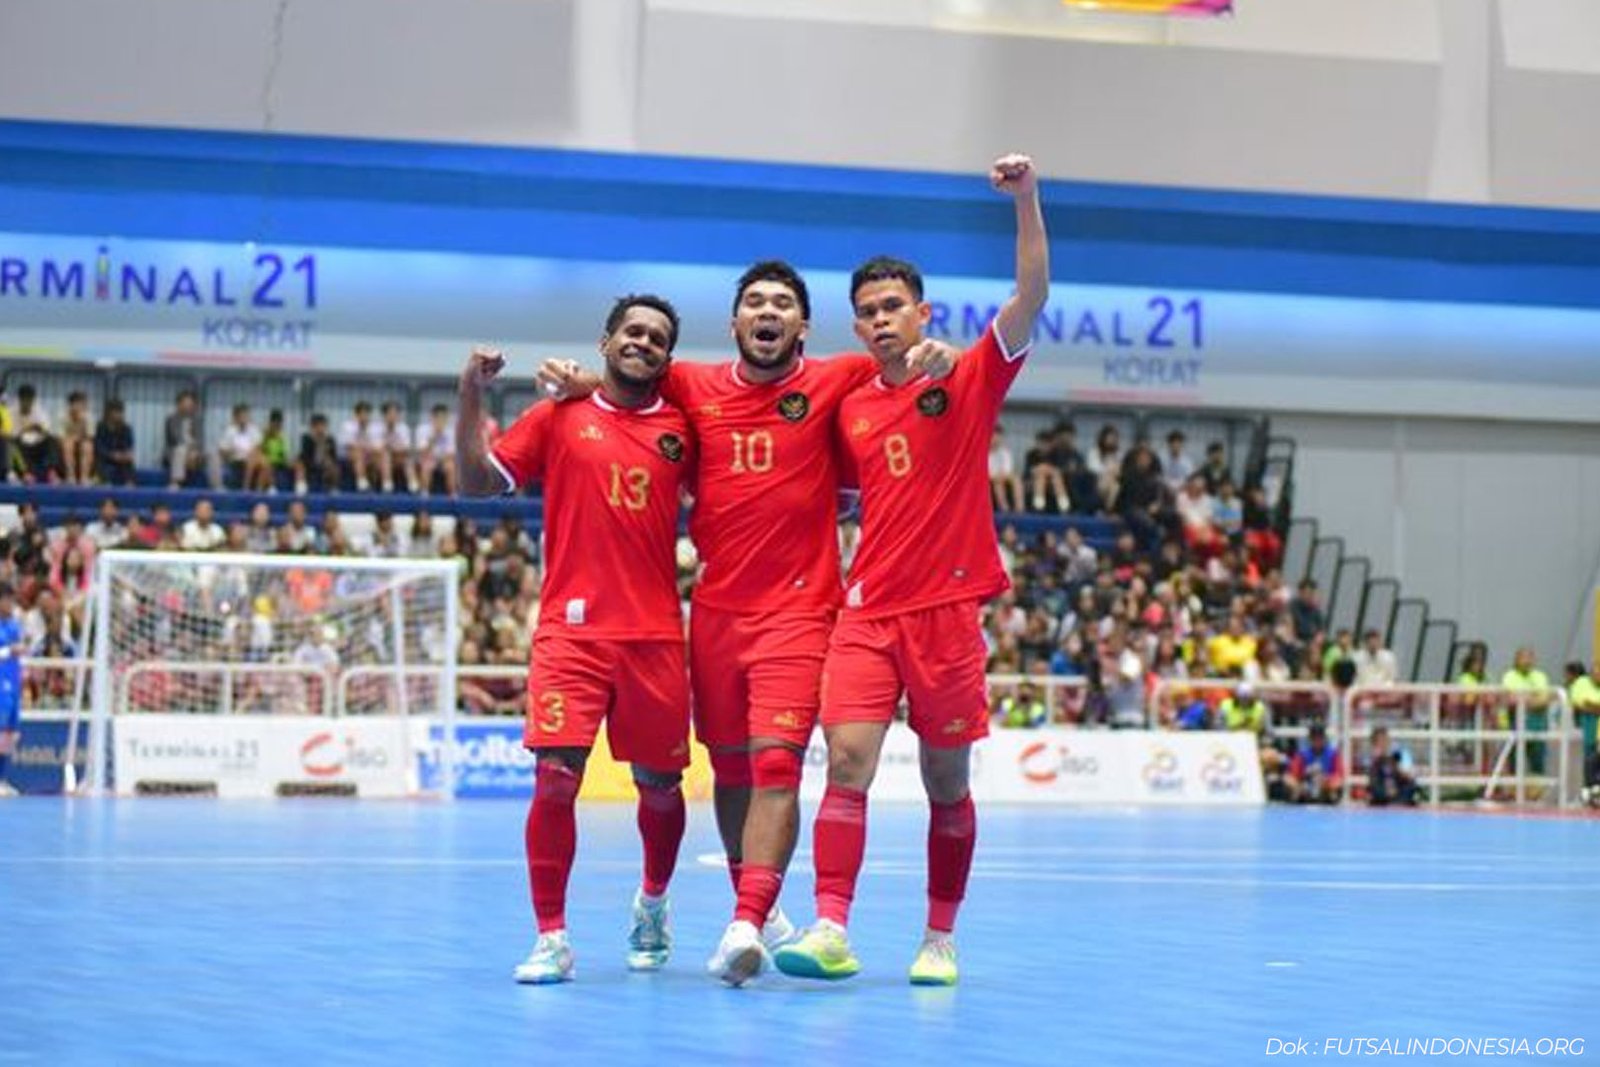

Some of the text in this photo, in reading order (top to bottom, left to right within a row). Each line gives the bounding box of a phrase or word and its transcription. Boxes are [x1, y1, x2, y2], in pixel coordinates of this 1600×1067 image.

[251, 253, 318, 308] 21
[202, 318, 314, 347] KORAT
[927, 297, 1203, 349] RMNAL 21
[1103, 355, 1201, 385] KORAT
[729, 430, 773, 473] 10
[884, 433, 912, 477] 8
[607, 463, 651, 511] 13
